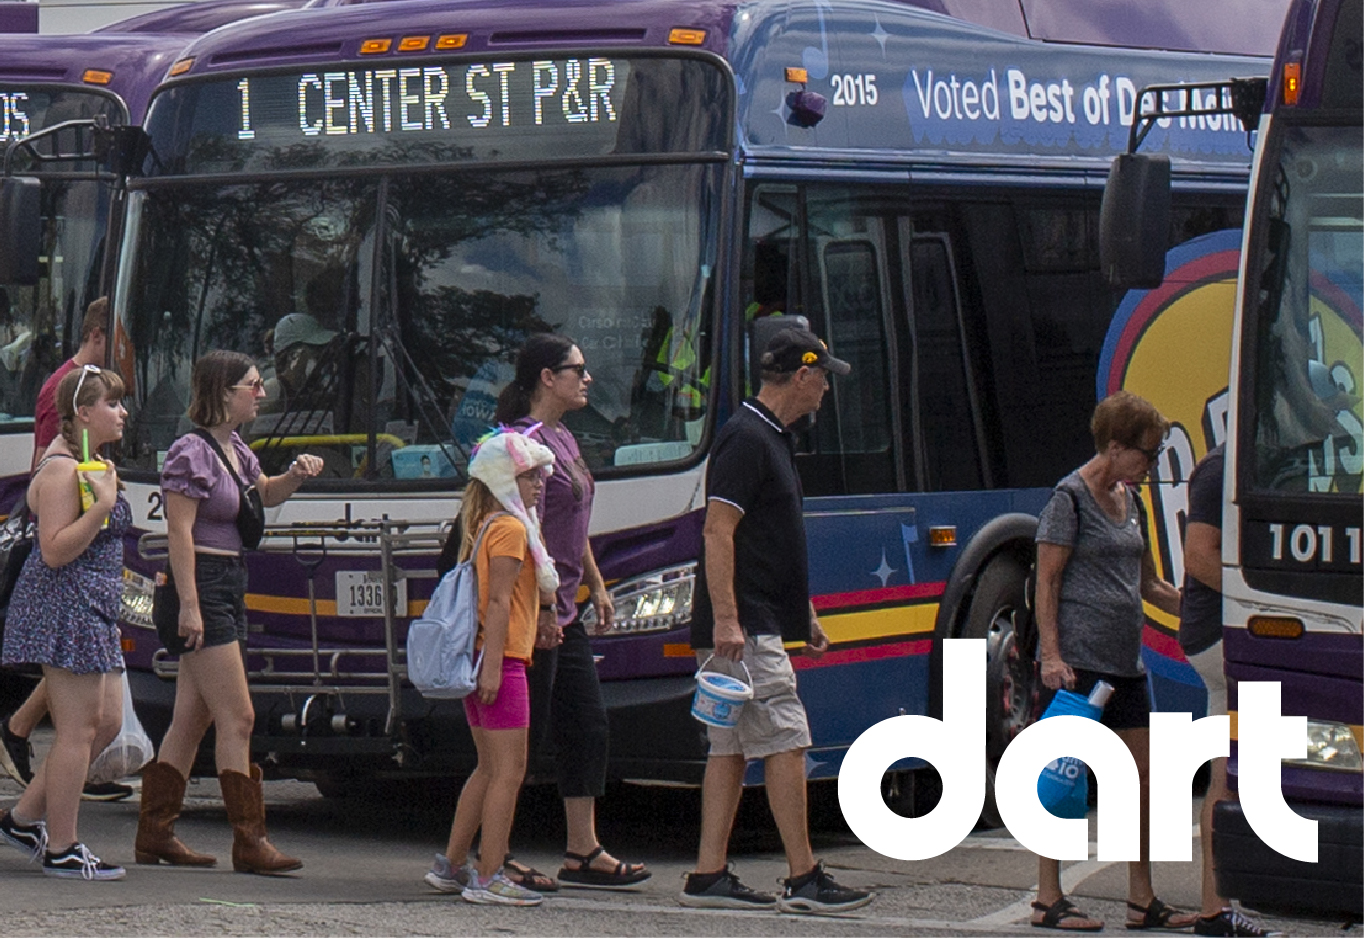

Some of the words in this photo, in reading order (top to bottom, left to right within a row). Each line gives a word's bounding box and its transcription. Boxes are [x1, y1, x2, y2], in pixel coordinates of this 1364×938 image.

[238, 78, 255, 140] 1
[298, 66, 451, 136] CENTER
[466, 62, 515, 127] ST
[532, 57, 618, 125] P&R
[831, 74, 878, 106] 2015
[912, 68, 1000, 120] Voted
[1007, 69, 1076, 124] Best
[1083, 74, 1110, 126] of
